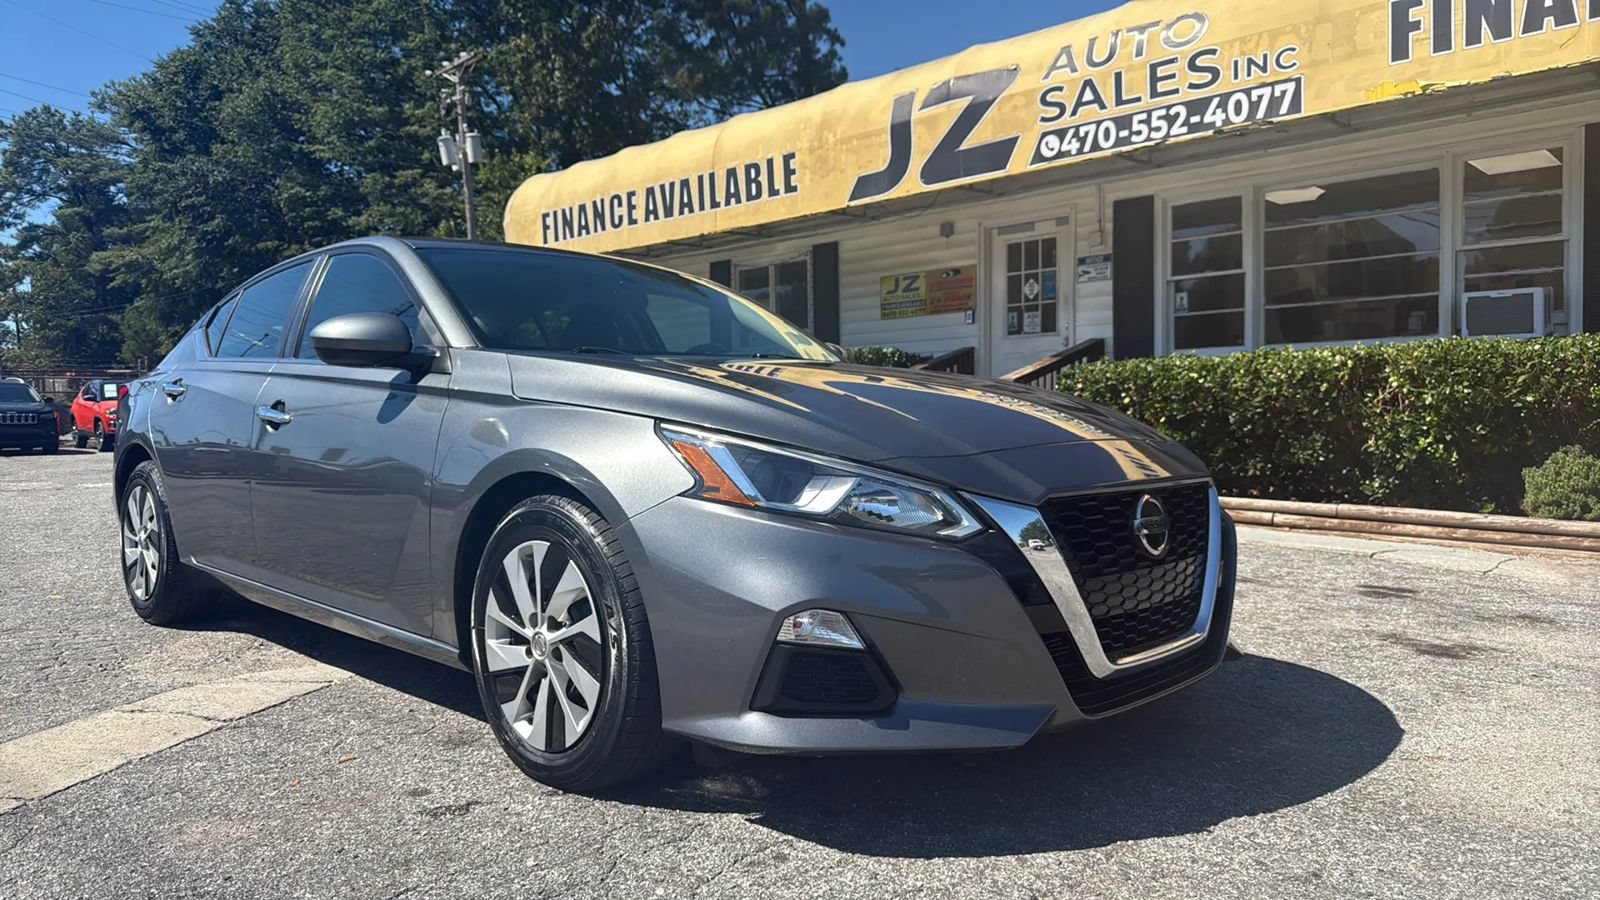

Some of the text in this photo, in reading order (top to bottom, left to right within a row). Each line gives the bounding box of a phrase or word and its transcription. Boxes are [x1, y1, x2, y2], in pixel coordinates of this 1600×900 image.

[1041, 12, 1209, 81] AUTO
[1390, 0, 1600, 64] FINA
[1039, 46, 1299, 124] SALES INC
[1060, 82, 1297, 154] 470-552-4077
[847, 66, 1021, 206] JZ
[541, 151, 799, 245] FINANCE AVAILABLE
[884, 274, 921, 295] JZ
